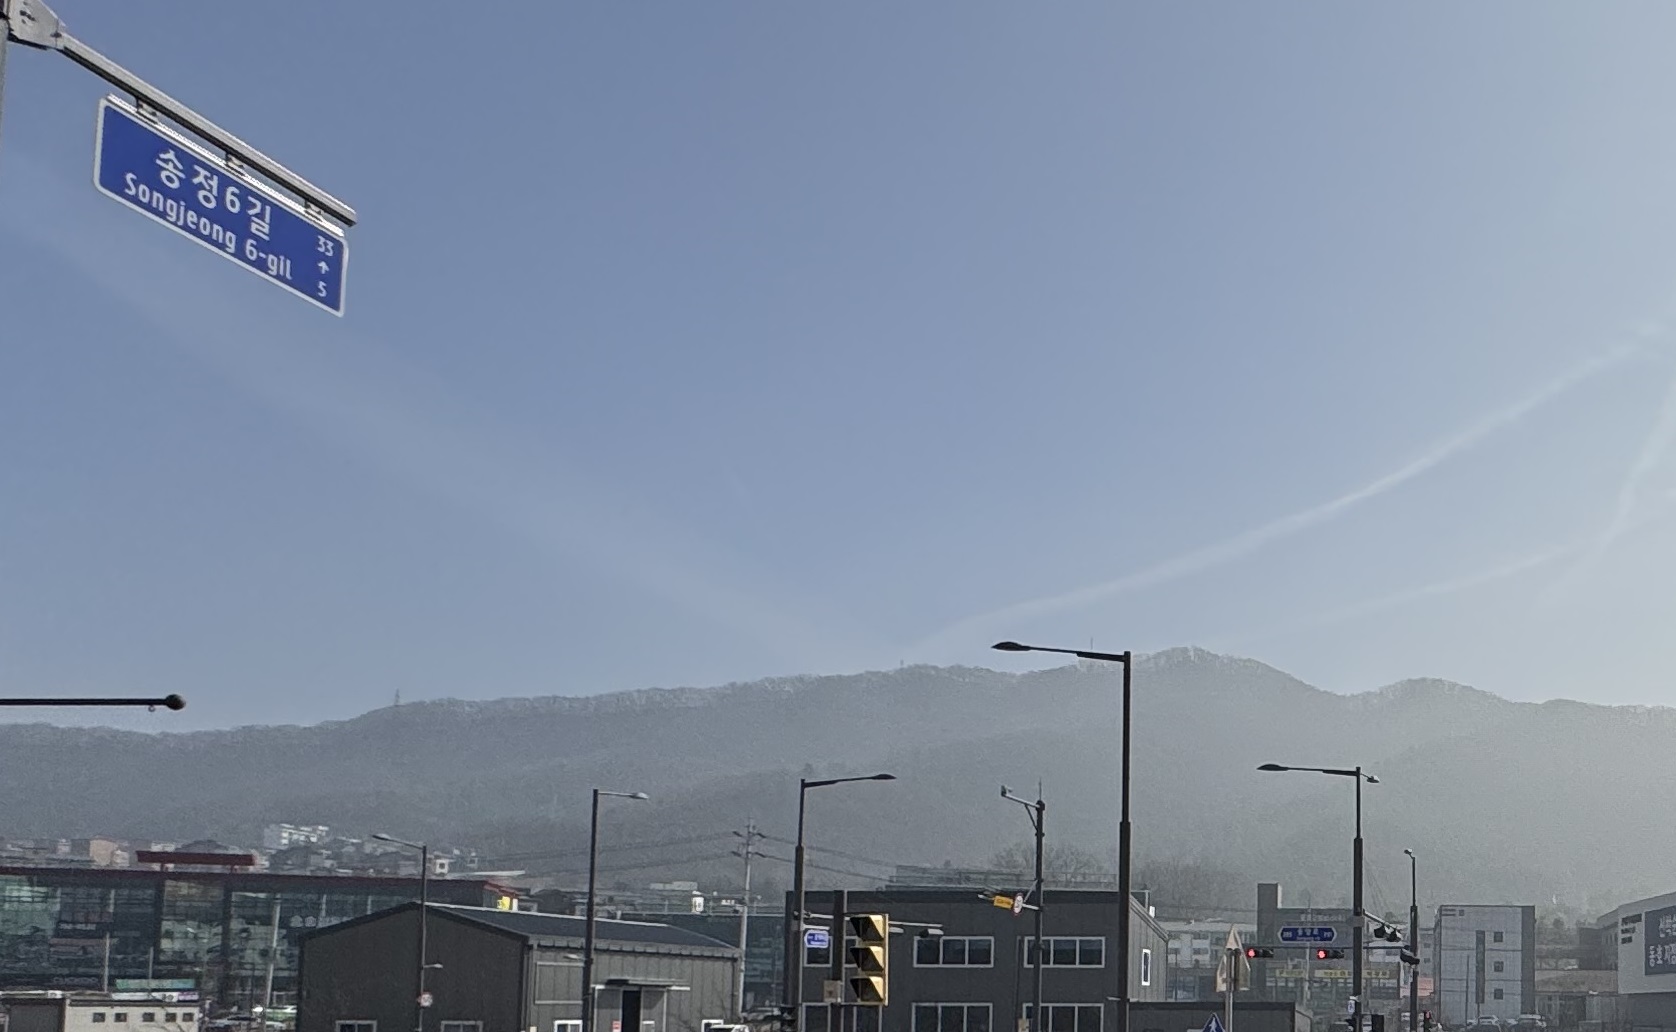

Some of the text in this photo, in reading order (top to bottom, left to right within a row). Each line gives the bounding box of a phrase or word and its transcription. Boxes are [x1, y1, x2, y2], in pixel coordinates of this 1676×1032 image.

[156, 149, 272, 242] 송정6길
[124, 172, 293, 281] Songjeong 6-gil
[317, 236, 334, 257] 33
[317, 282, 328, 297] 5
